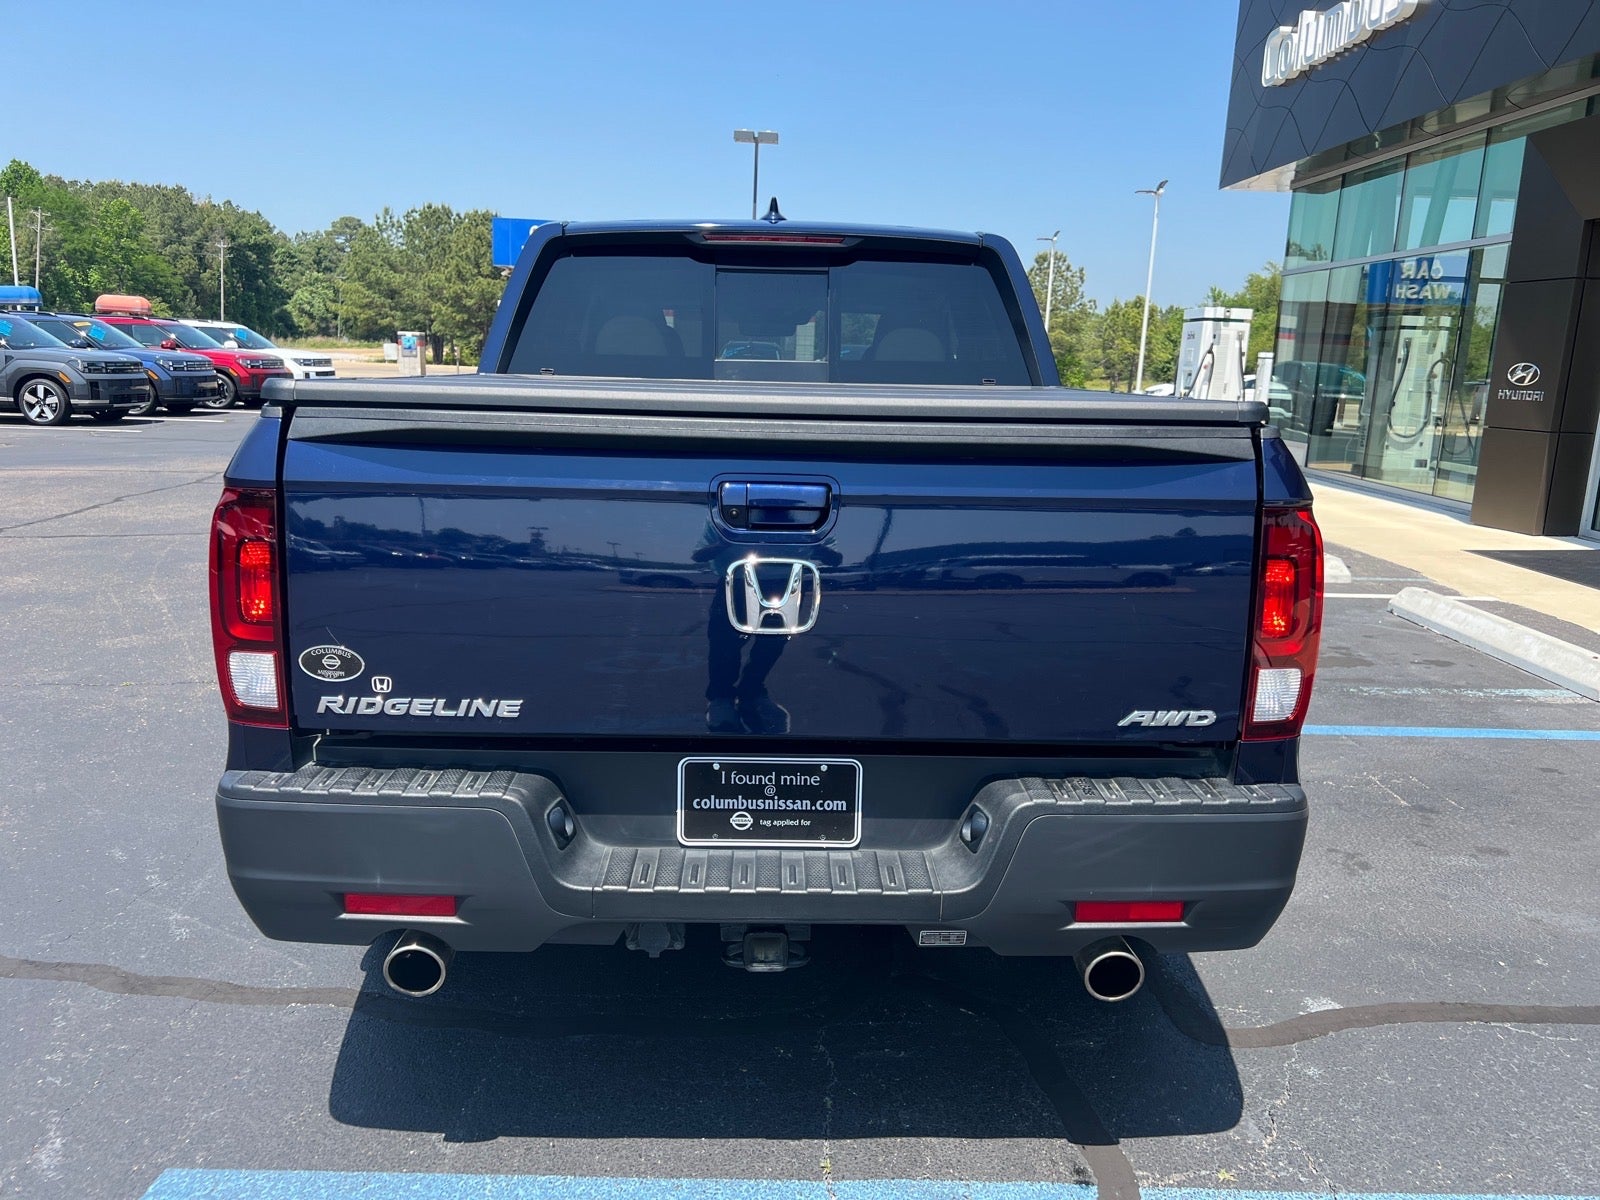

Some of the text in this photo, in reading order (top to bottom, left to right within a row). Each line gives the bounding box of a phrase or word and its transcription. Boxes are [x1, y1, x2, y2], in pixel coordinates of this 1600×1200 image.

[1497, 389, 1545, 402] HYUNDAI
[310, 648, 352, 659] COLUMBUS
[316, 695, 523, 718] RIDGELINE
[1117, 709, 1217, 726] AWD
[721, 771, 821, 786] I found mine
[764, 785, 777, 796] @
[692, 795, 847, 811] columbusnissan.com
[759, 819, 772, 827] tag
[772, 819, 799, 827] applied
